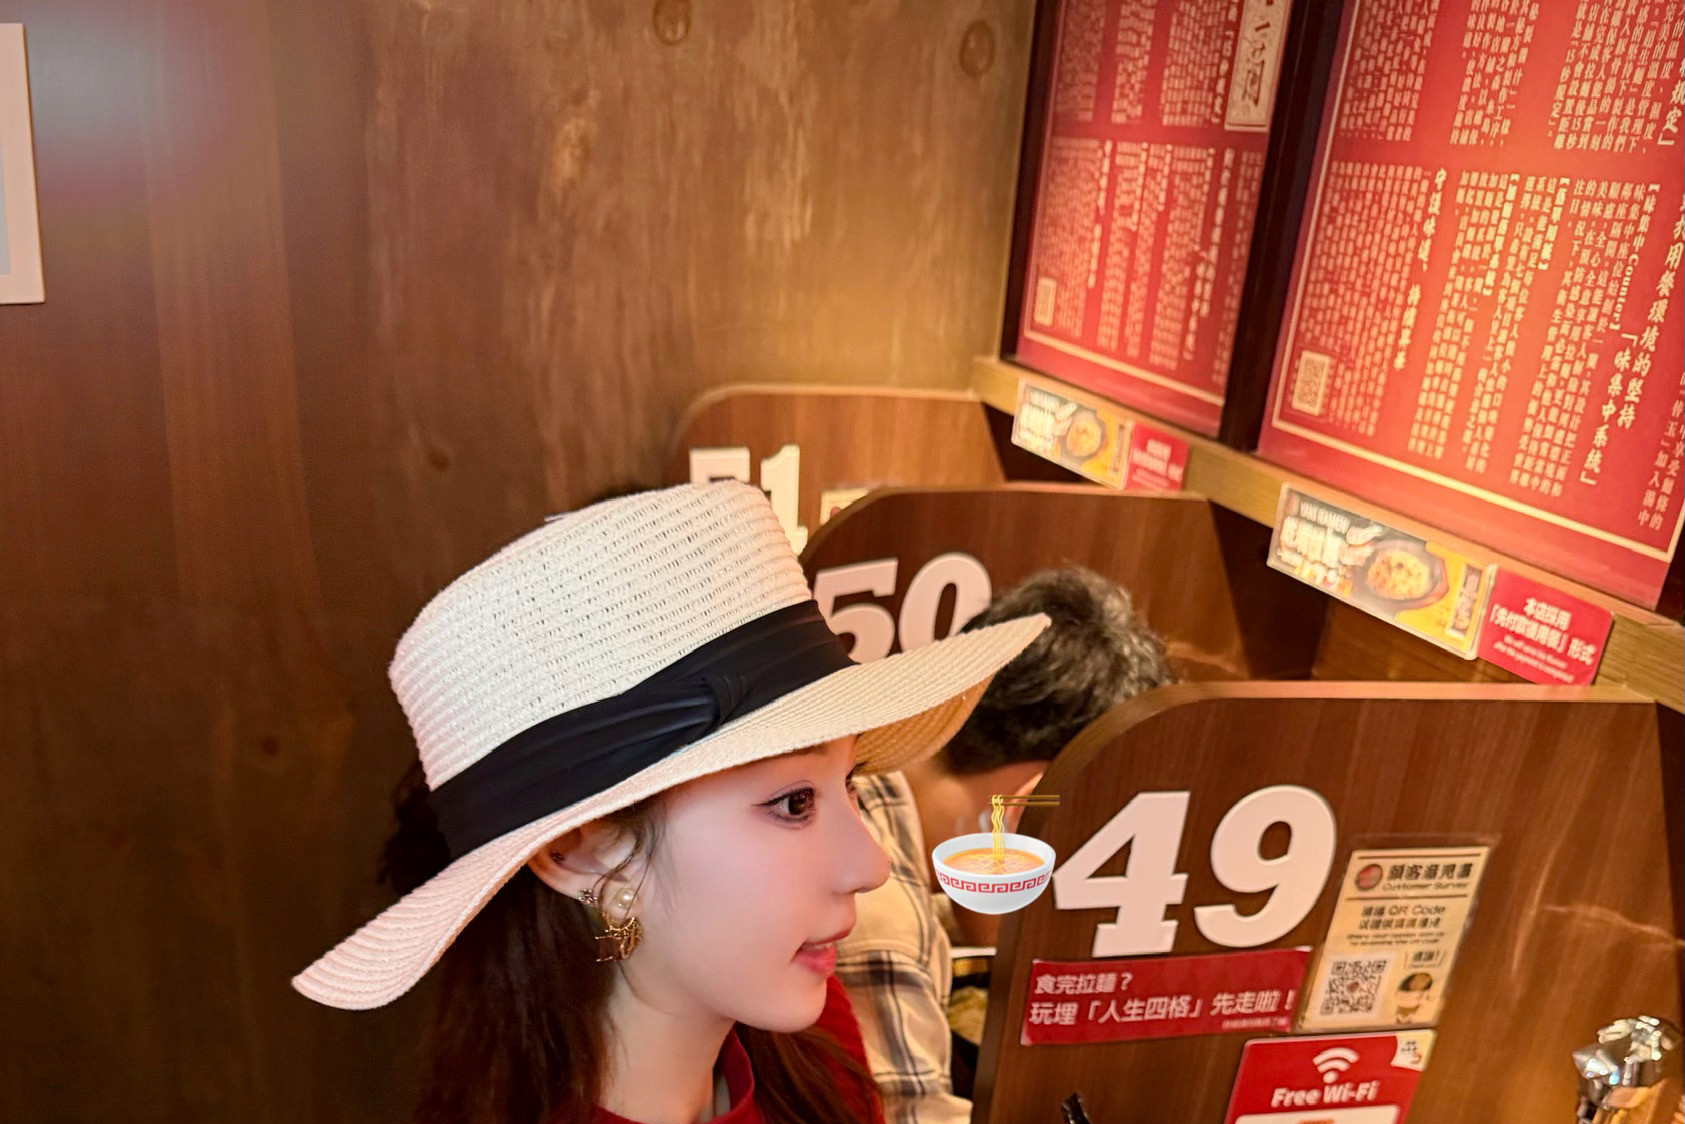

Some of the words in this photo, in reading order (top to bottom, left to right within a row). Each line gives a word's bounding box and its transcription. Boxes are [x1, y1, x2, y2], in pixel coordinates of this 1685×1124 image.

[1579, 333, 1639, 485] 「味集中系統」
[813, 551, 992, 665] 50
[1052, 784, 1337, 957] 49
[1271, 1087, 1321, 1108] Free
[1323, 1080, 1380, 1103] Wi-Fi
